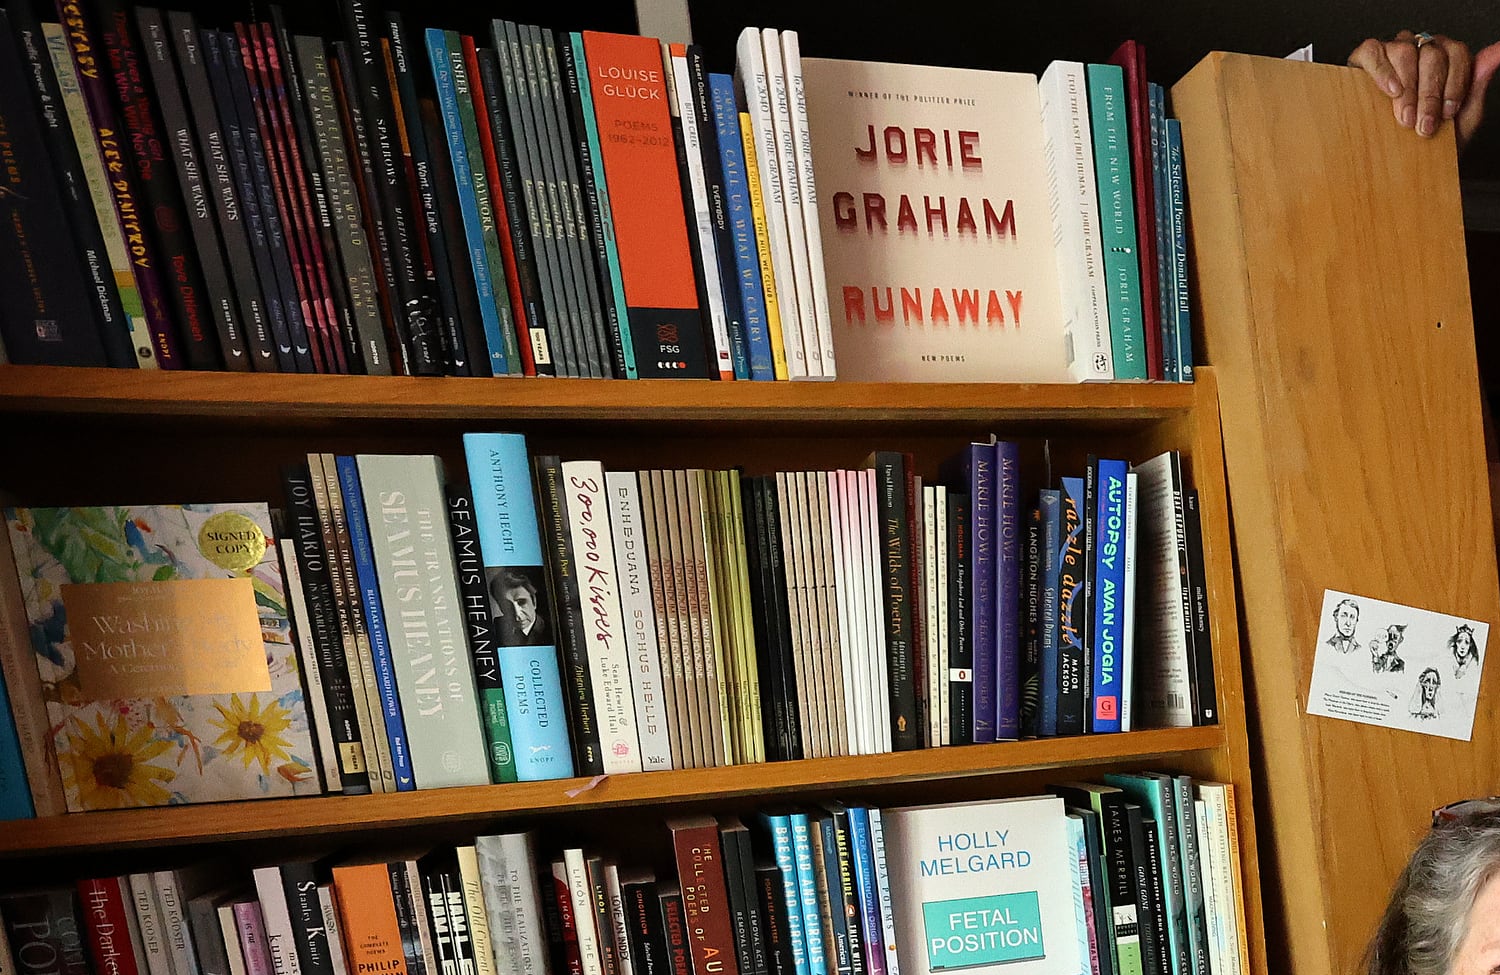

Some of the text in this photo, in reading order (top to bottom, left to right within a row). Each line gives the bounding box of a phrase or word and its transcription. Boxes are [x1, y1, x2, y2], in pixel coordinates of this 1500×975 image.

[451, 52, 469, 95] FISHER
[598, 66, 659, 83] LOUISE
[848, 91, 976, 106] WINNER OF THE PULITZER PRIZE
[855, 124, 982, 169] JORIE
[1104, 87, 1124, 235] FROM THE NEW WORLD
[1171, 146, 1181, 163] The
[176, 128, 207, 219] WHAT SHE WANTS
[1171, 164, 1183, 207] Selected
[474, 172, 492, 232] DAYWORK
[833, 191, 1017, 238] GRAHAM
[1173, 208, 1183, 238] Poems
[1177, 253, 1187, 291] Donald
[843, 285, 1023, 328] RUNAWAY
[1180, 292, 1190, 312] Hall
[660, 345, 680, 354] FSG
[489, 449, 515, 554] ANTHONY HECHT
[207, 530, 257, 542] SIGNED
[288, 479, 323, 572] JOY HARJO
[618, 487, 639, 596] ENHEDUANA
[888, 518, 899, 537] The
[215, 543, 252, 554] COPY
[888, 537, 903, 572] Wilds
[1030, 527, 1038, 579] LANGSTON
[450, 497, 496, 682] SEAMUS HEANEY
[1062, 496, 1083, 645] razzle dazzle
[1101, 476, 1122, 686] AUTOPSY AVAN JOGIA
[379, 491, 444, 719] SEAMUS HEANEY
[587, 566, 610, 651] Kisses
[892, 594, 906, 636] Poetry
[633, 609, 657, 736] SOPHUS HELLE
[1062, 653, 1070, 694] JACKSON
[515, 675, 529, 715] POEMS
[529, 659, 549, 729] COLLECTED
[647, 755, 665, 764] Yale
[938, 829, 1010, 851] HOLLY
[920, 851, 1032, 877] MELGARD
[297, 880, 316, 922] Stanley
[794, 825, 824, 964] BREAD AND CIRCUS
[949, 908, 1018, 931] FETAL
[932, 928, 1039, 956] POSITION
[358, 960, 400, 973] PHILIP
